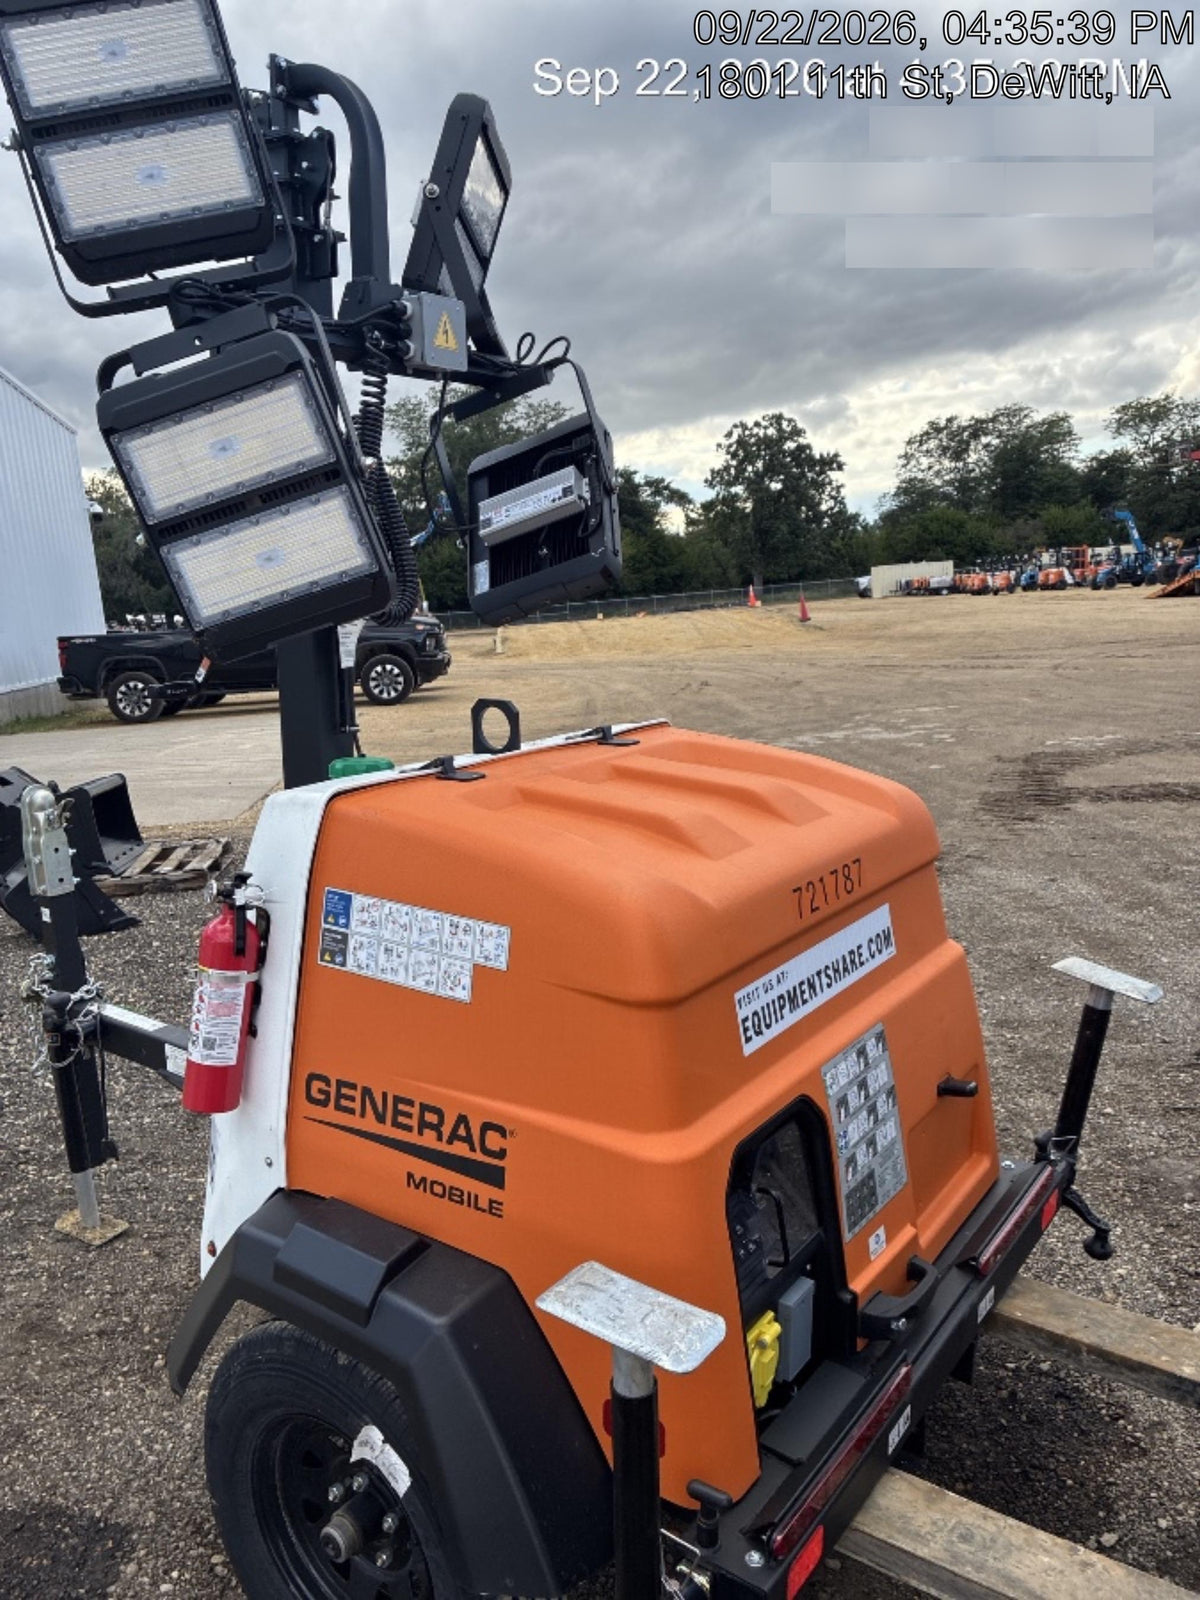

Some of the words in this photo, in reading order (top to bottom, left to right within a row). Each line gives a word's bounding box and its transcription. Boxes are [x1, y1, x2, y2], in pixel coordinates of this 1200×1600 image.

[792, 858, 862, 919] 721787
[737, 986, 760, 1010] VISIT
[762, 979, 774, 995] US
[741, 926, 893, 1044] EQUIPMENTSHARE.COM
[305, 1072, 507, 1161] GENERAC
[406, 1171, 504, 1218] MOBILE
